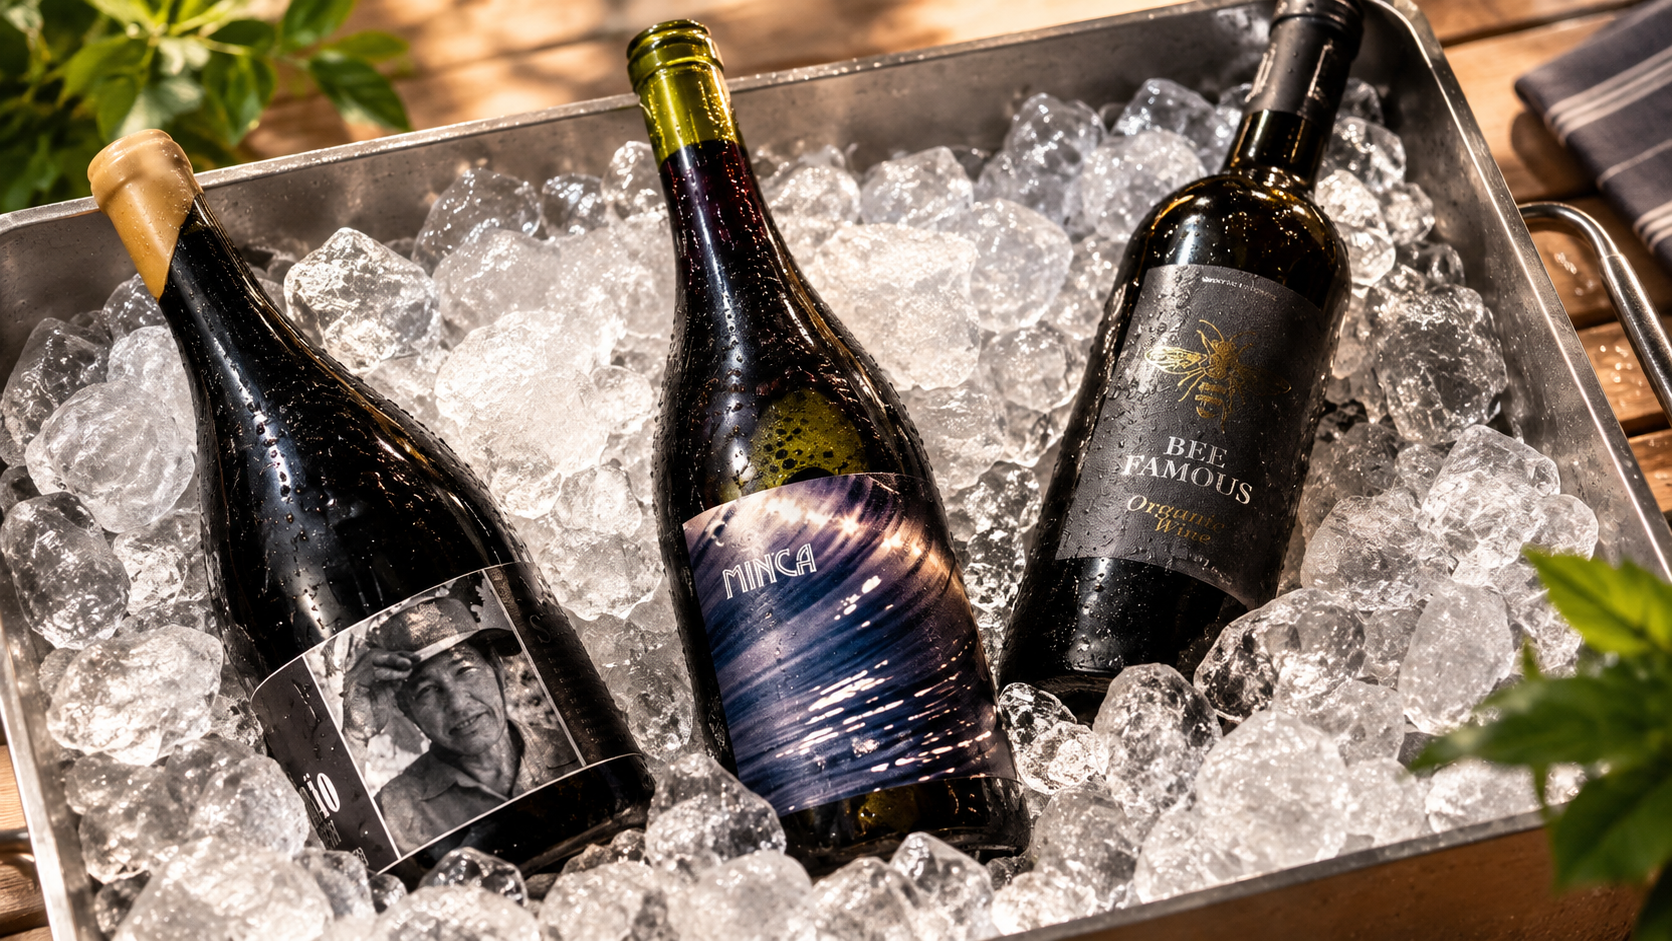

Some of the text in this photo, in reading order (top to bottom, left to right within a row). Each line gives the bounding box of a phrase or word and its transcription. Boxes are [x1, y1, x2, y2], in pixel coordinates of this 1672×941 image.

[1163, 436, 1228, 469] BEE
[1120, 455, 1253, 505] FAMOUS
[1127, 494, 1225, 532] Organic
[1155, 518, 1211, 544] Wine
